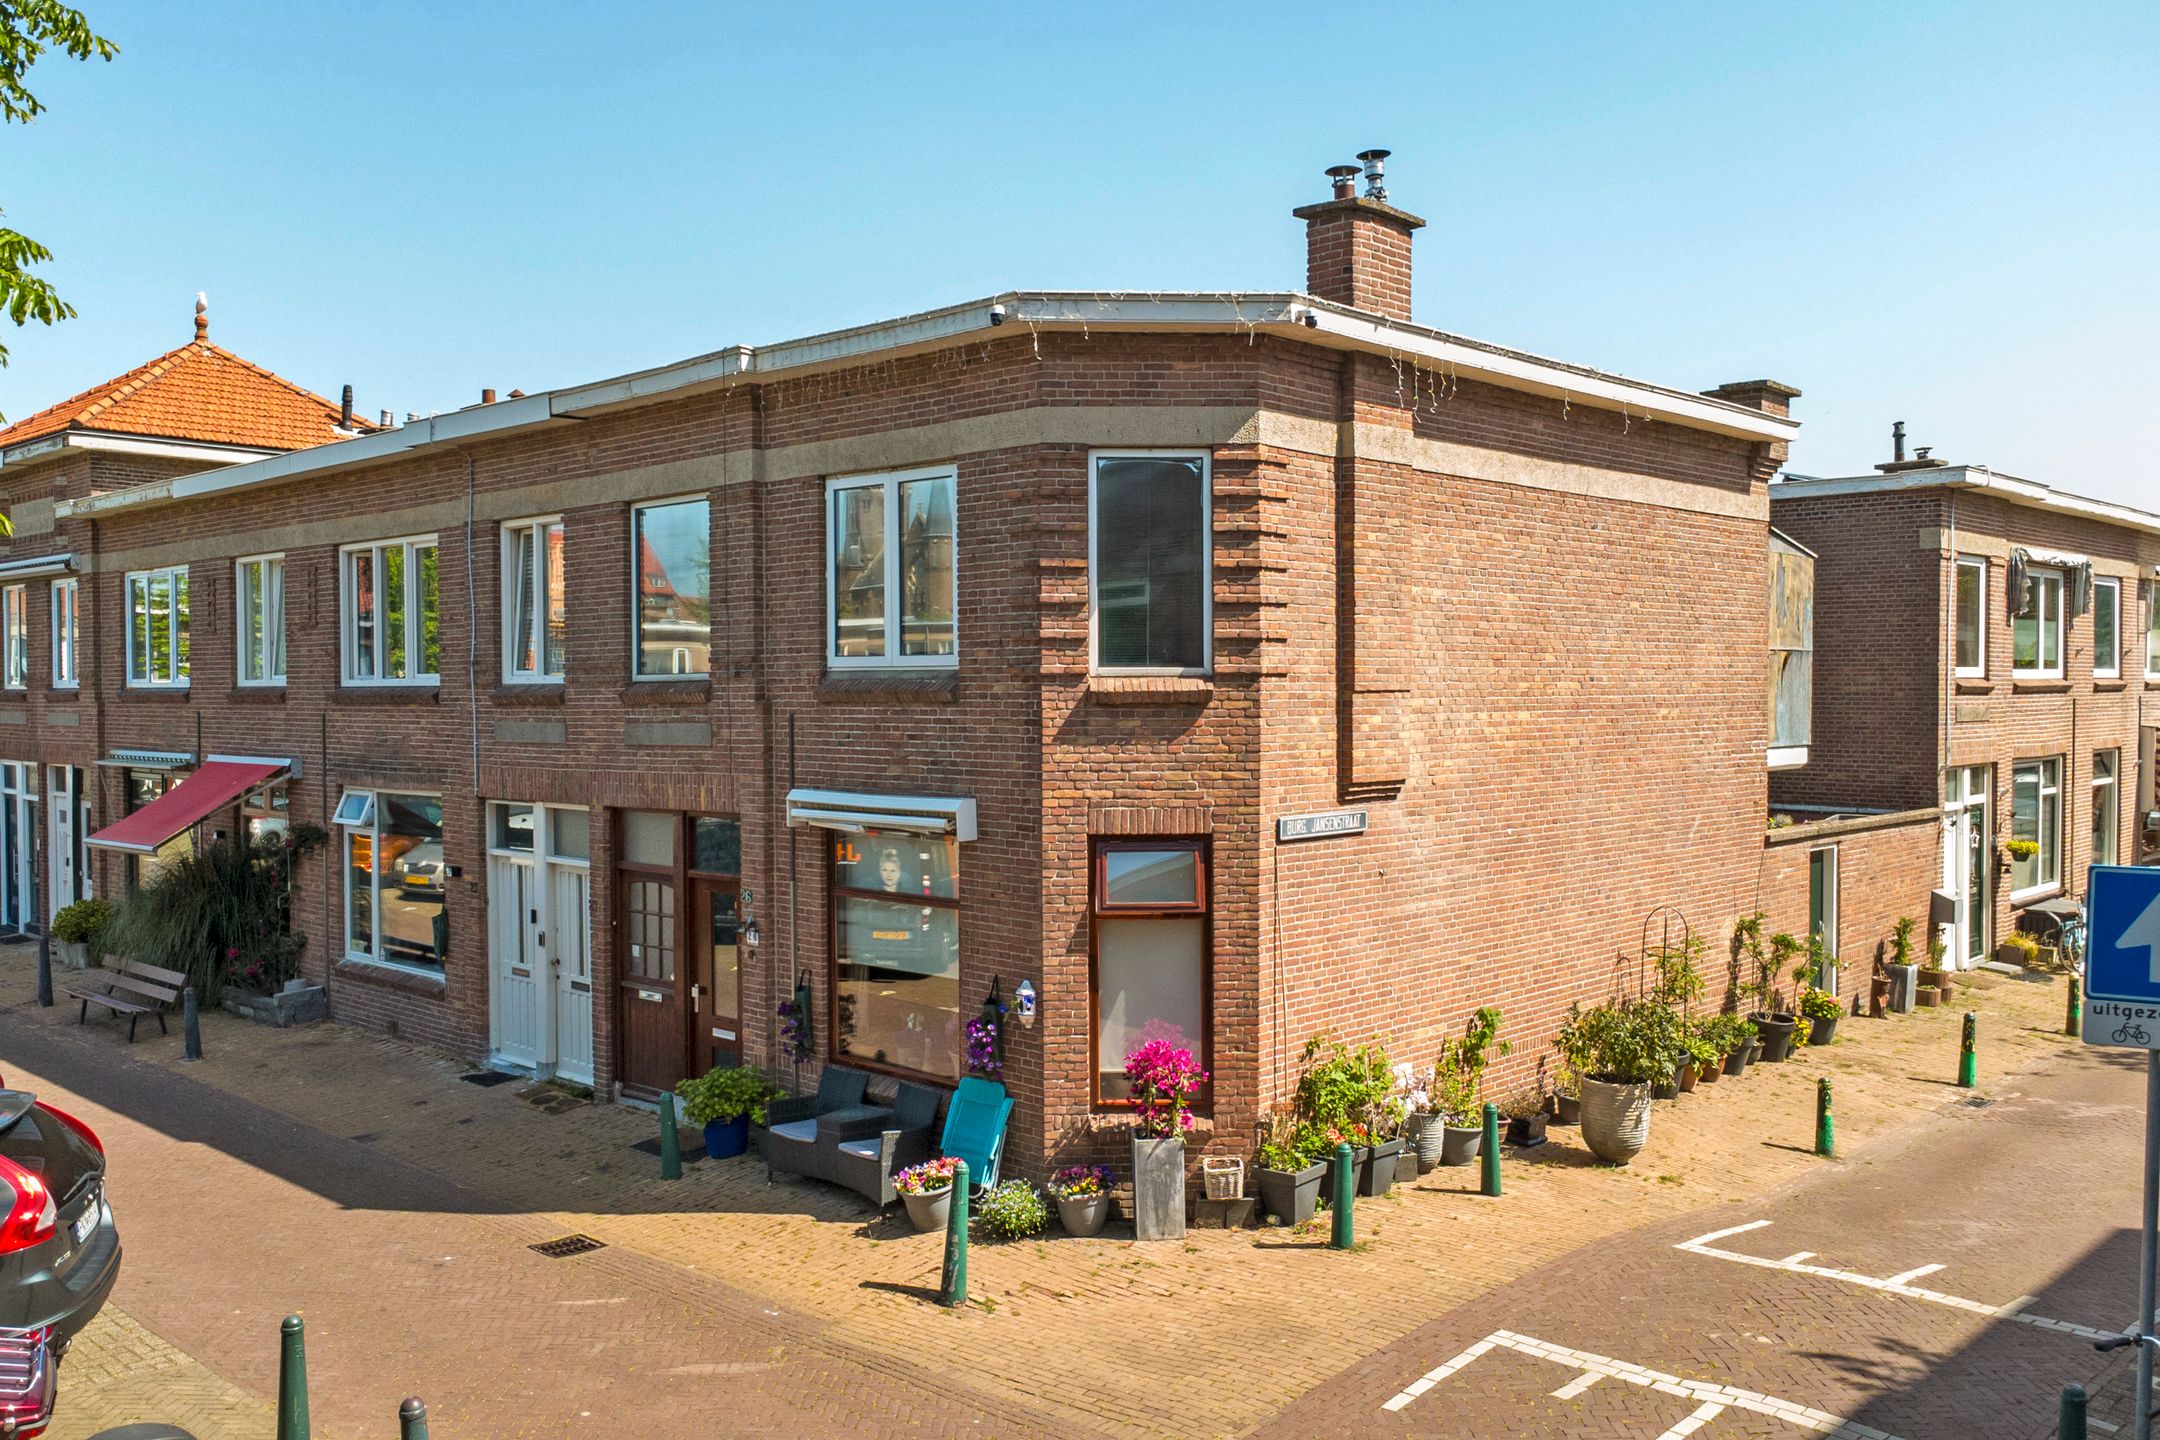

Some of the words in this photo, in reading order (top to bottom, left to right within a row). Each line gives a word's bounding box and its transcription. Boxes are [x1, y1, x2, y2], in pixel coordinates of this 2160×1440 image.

[1286, 819, 1308, 835] BURG.
[1311, 813, 1361, 833] JANSENSTRAAT
[740, 889, 752, 904] 26
[2093, 1003, 2160, 1021] uitgez
